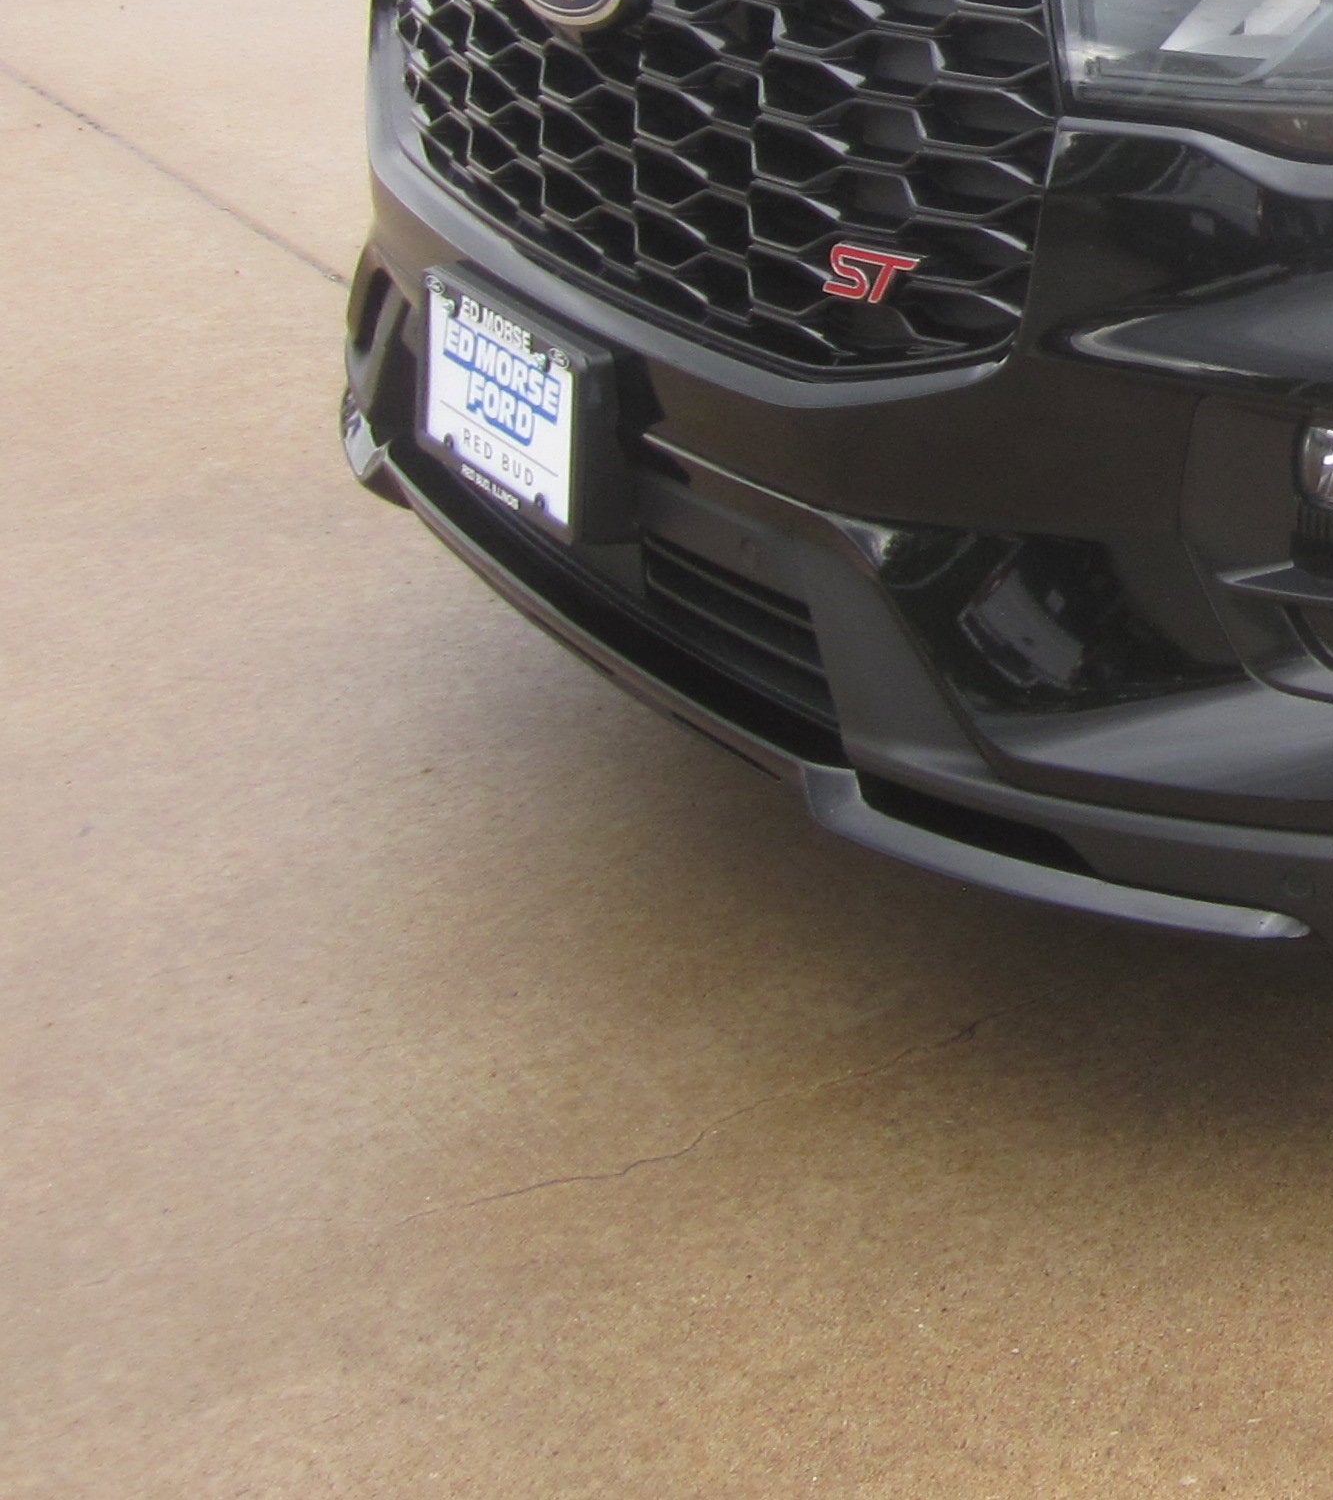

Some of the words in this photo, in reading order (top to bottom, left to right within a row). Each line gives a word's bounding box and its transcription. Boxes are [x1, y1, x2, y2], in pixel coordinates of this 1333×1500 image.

[822, 243, 920, 304] ST
[459, 295, 480, 324] ED
[482, 306, 532, 352] MORSE
[443, 318, 475, 371] ED
[474, 333, 562, 426] MORSE
[466, 370, 535, 447] FORD
[463, 428, 492, 460] RED
[501, 453, 534, 486] BUD
